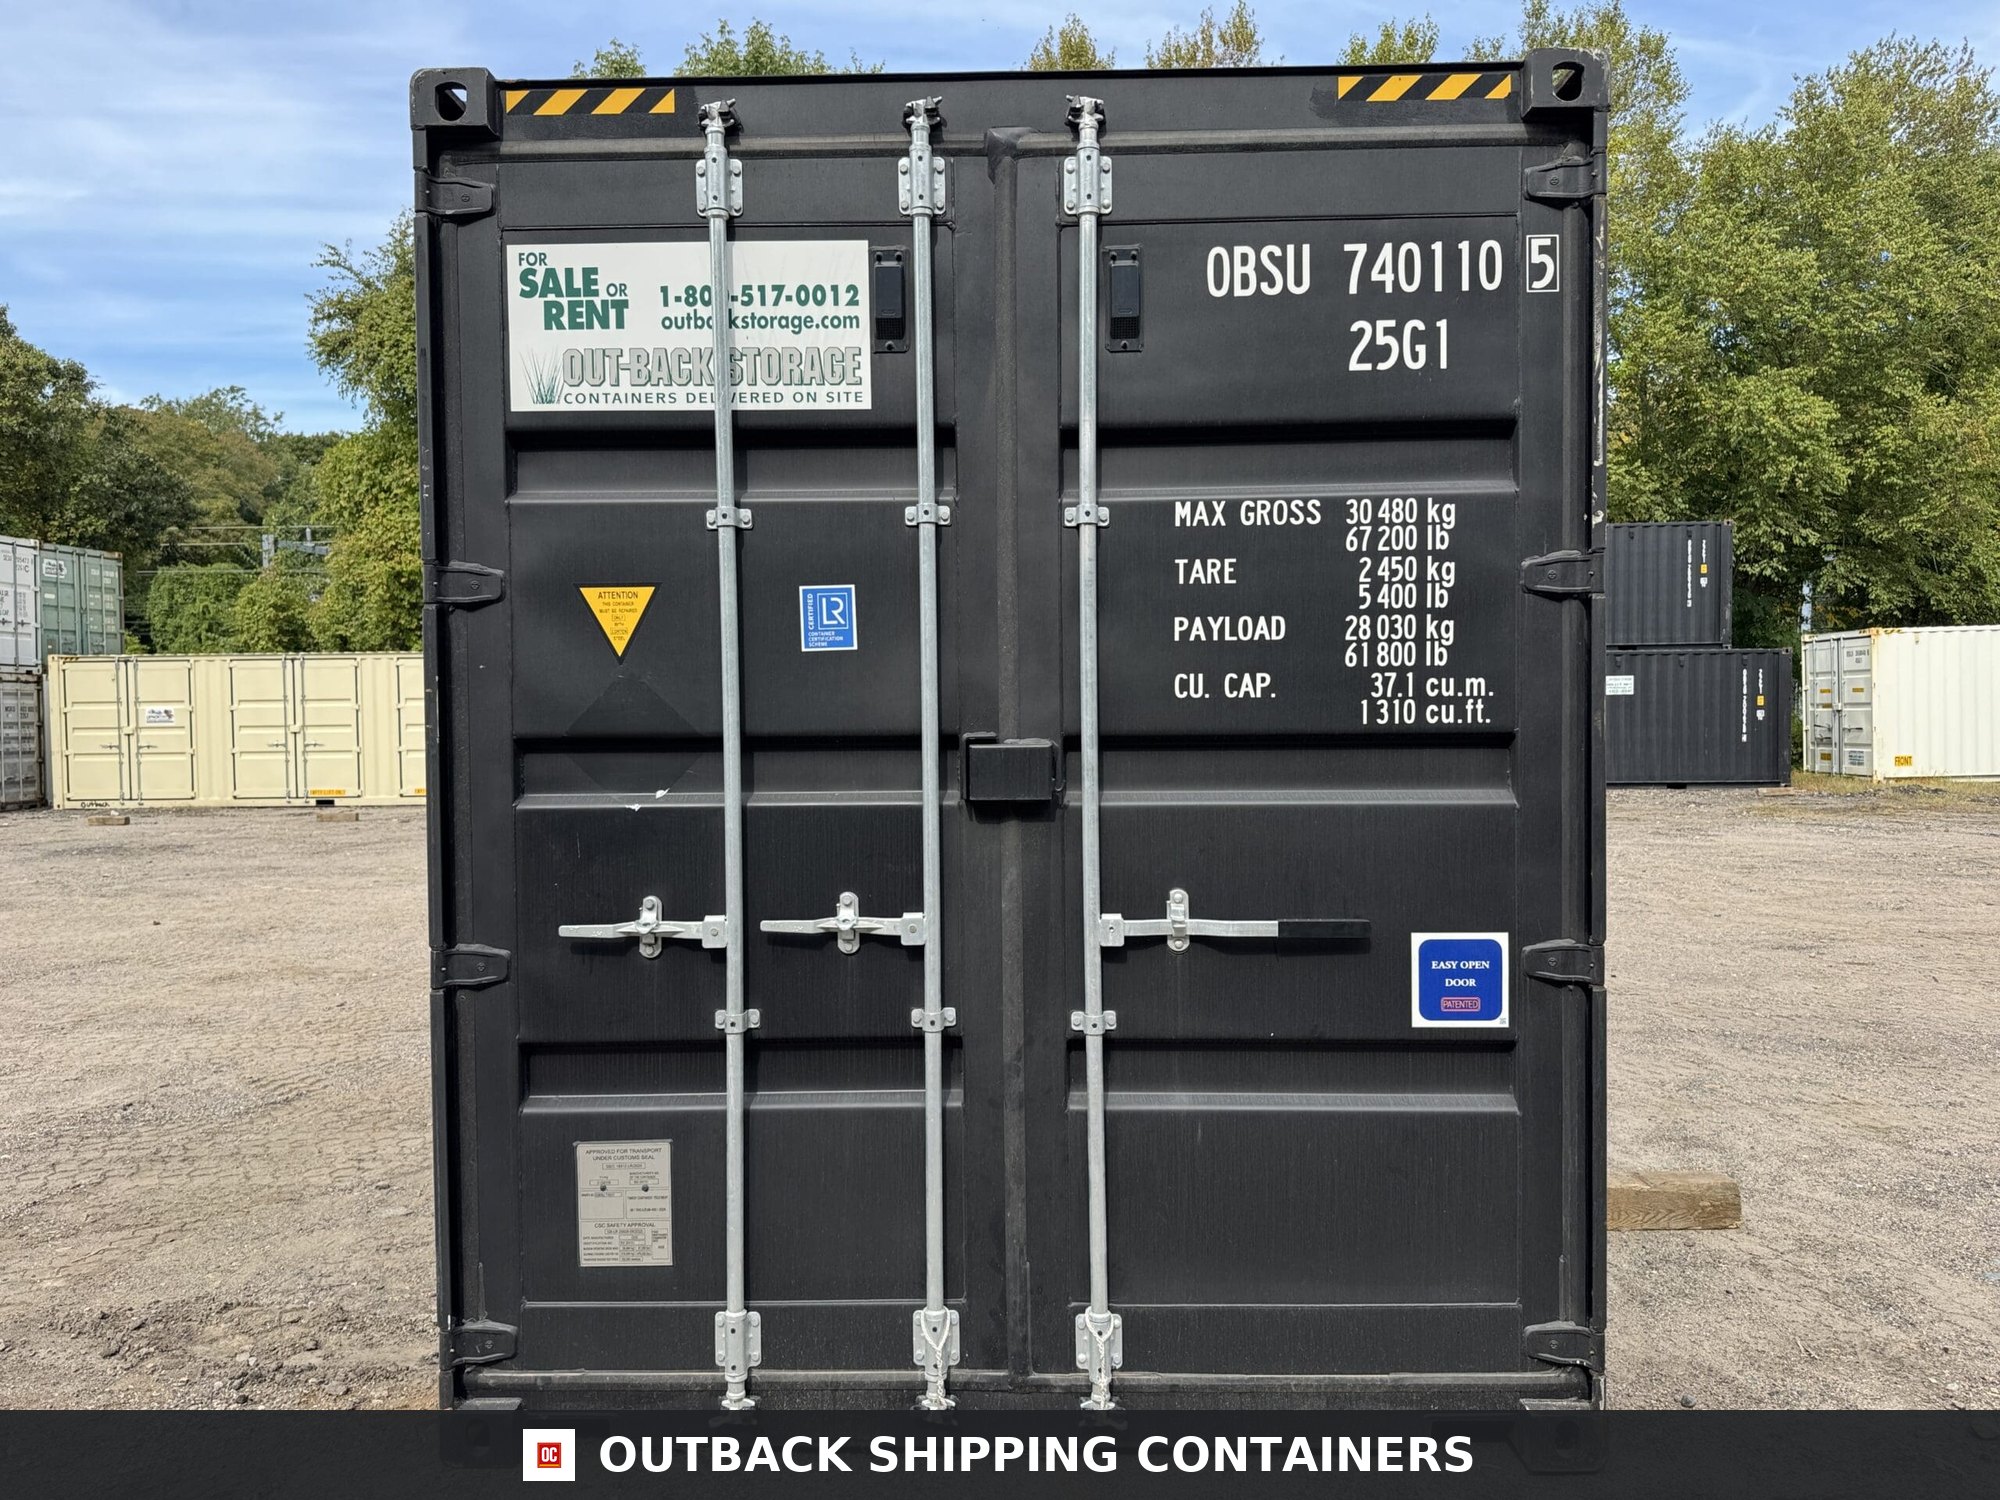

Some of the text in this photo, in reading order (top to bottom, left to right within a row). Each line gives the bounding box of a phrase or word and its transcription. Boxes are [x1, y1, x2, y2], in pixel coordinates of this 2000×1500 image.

[519, 252, 547, 266] FOR
[1207, 237, 1556, 297] OBSU 740110 5
[520, 267, 627, 298] SALE OR
[659, 283, 860, 308] 1-80-517-0012
[544, 299, 629, 330] RENT
[1349, 319, 1447, 371] 25G1
[562, 346, 862, 387] OUT-BACK STORAGE
[564, 392, 677, 404] CONTAINERS
[792, 392, 817, 403] ON
[826, 391, 863, 403] SITE
[1175, 498, 1455, 531] MAX GROSS 30 480 kg
[1346, 523, 1451, 551] 67 200 lb
[1175, 556, 1455, 589] TARE 2 450 kg
[597, 591, 638, 599] ATTENTION
[1359, 581, 1451, 609] 5 400 lb
[822, 597, 845, 624] LR
[1175, 614, 1454, 647] PAYLOAD 28 030 kg
[1345, 639, 1450, 667] 61 800 lb
[1175, 672, 1493, 698] CU. CAP. 37.1 cu.m.
[1361, 699, 1490, 724] 1 310 cu.ft.
[1432, 961, 1489, 969] EASY OPEN
[1443, 1000, 1479, 1009] PATENTED
